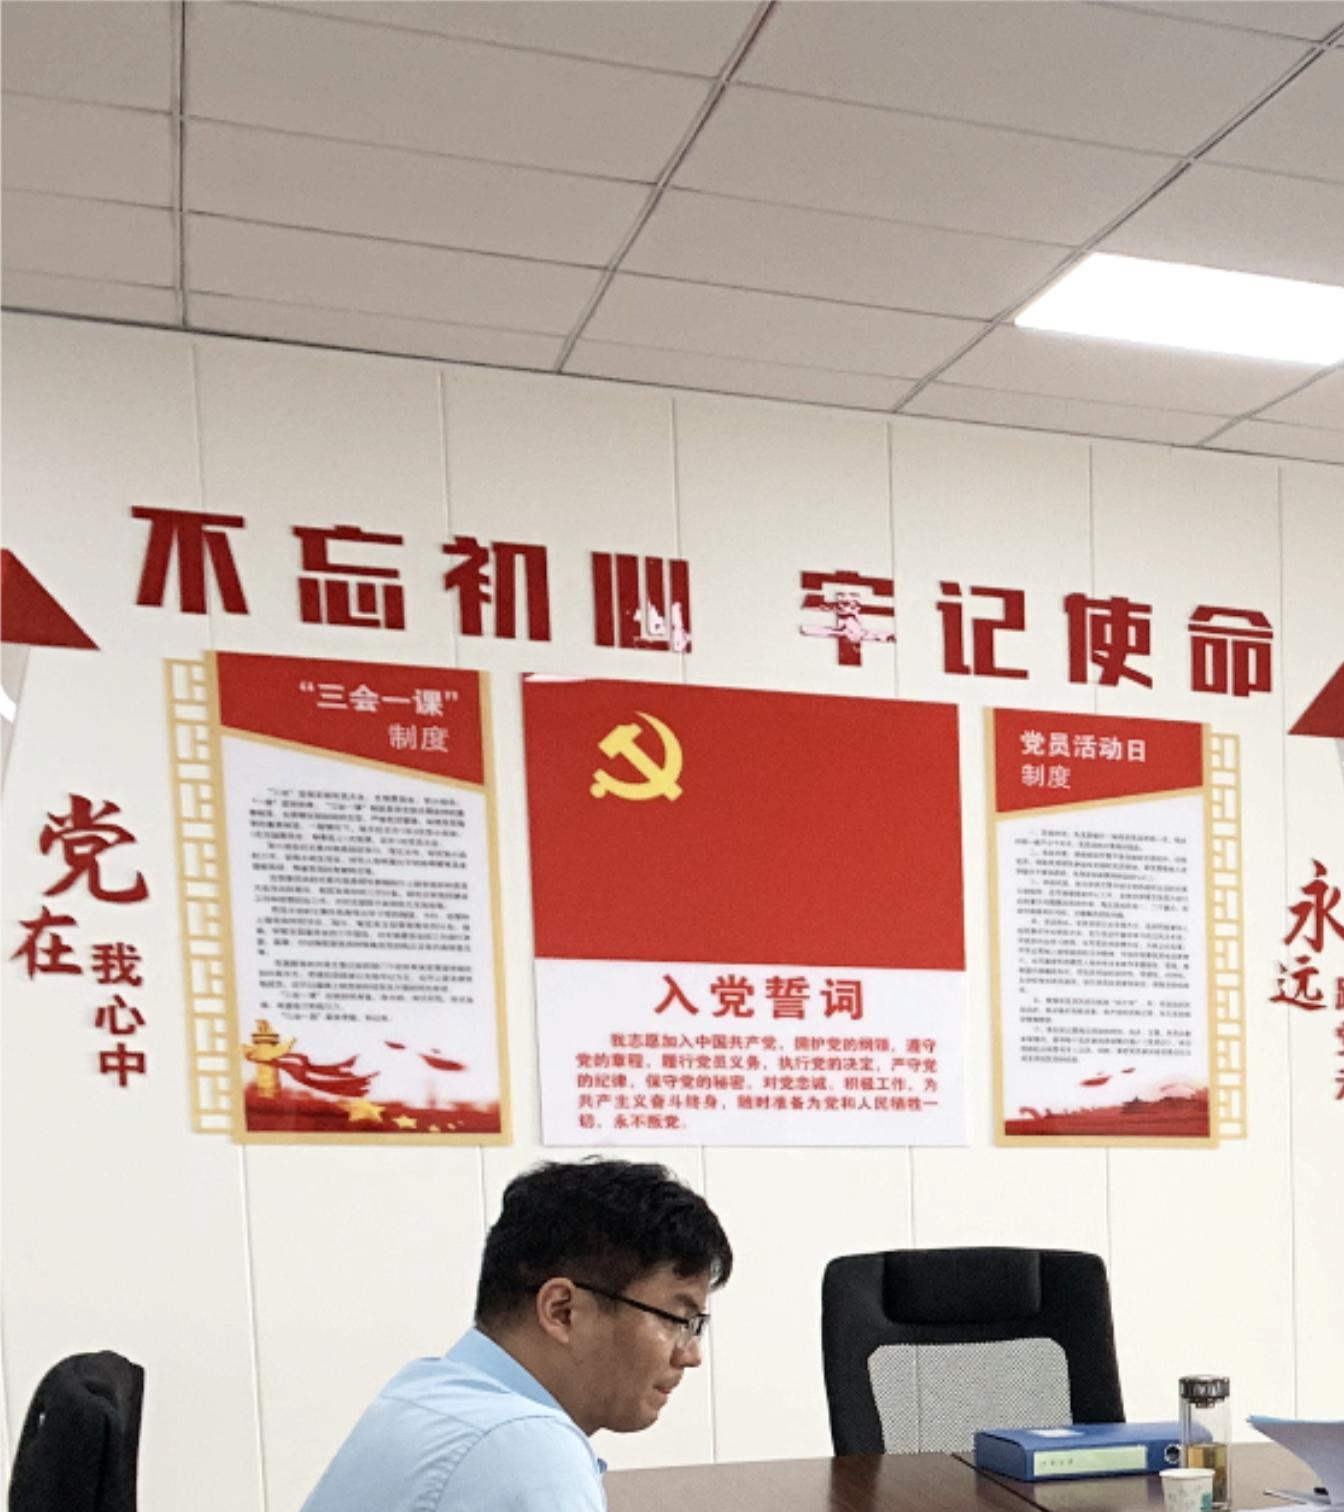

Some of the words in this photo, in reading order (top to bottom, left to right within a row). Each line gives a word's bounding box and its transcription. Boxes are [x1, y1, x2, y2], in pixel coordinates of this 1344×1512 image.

[131, 505, 692, 653] 不忘初心
[799, 569, 1275, 698] 牢记使命
[388, 722, 449, 752] 制度
[1020, 729, 1147, 763] 党员活动日
[1021, 763, 1072, 790] 制度
[92, 940, 148, 1088] 我心中
[653, 973, 865, 1020] 入党誓词
